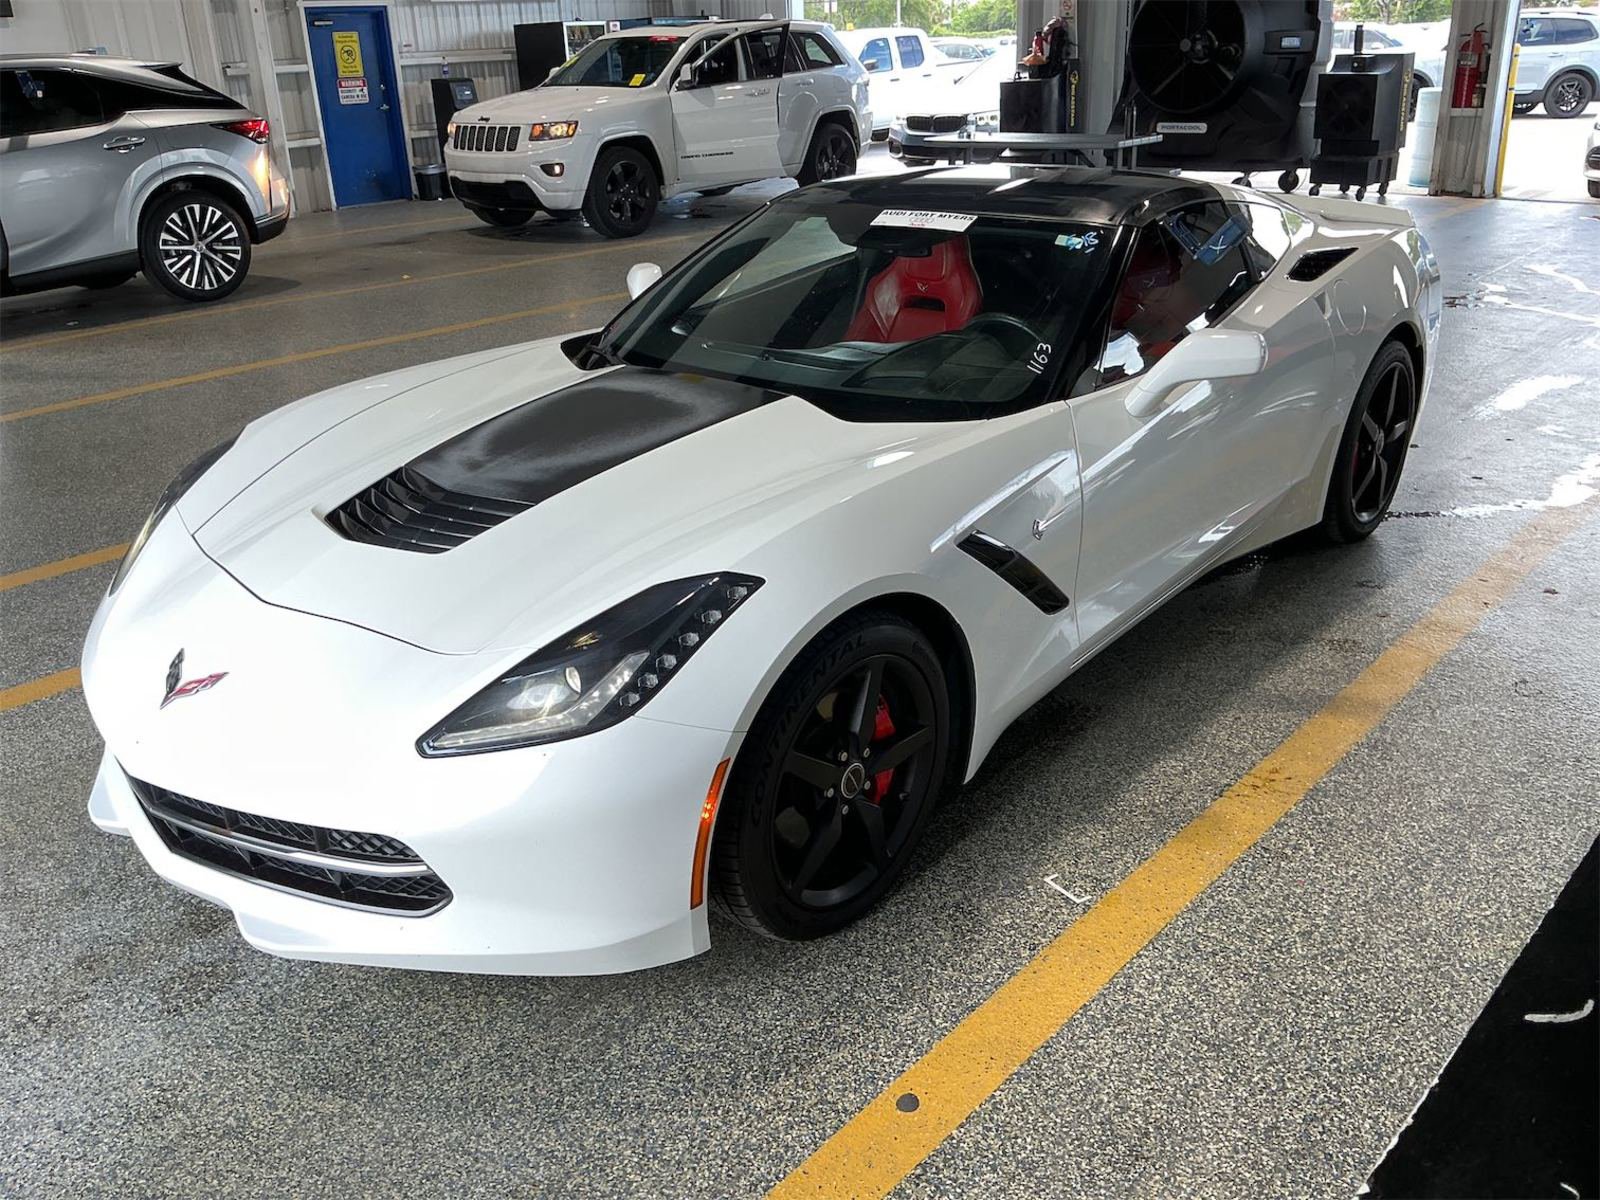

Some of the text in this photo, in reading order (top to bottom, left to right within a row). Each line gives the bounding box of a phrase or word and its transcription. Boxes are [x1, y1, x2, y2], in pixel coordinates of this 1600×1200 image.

[908, 211, 937, 219] FORT
[937, 213, 976, 222] MYERS
[1026, 342, 1052, 375] 1163
